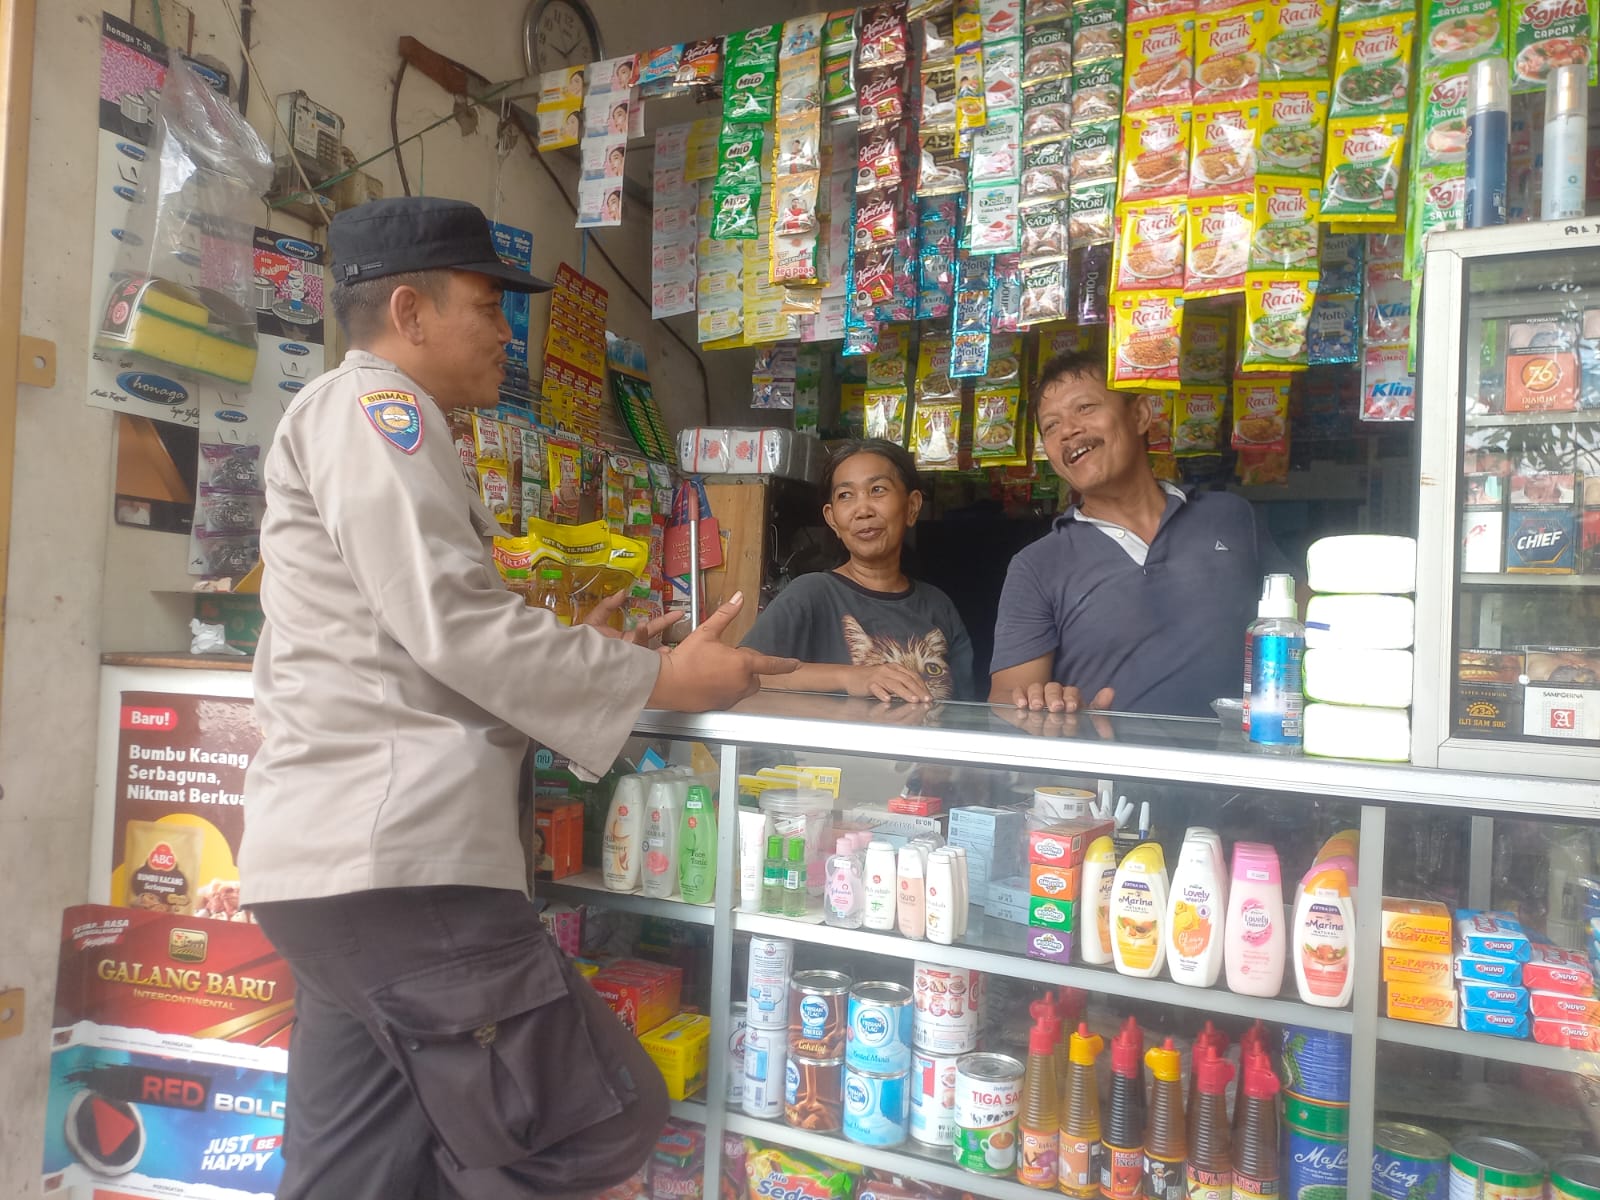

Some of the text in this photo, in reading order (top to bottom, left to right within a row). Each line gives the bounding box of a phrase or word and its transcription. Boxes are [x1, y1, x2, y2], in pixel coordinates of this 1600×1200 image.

[1278, 4, 1322, 24] Racik
[1438, 1, 1492, 16] SAYUR SOP
[1522, 0, 1587, 28] Sajiku
[1209, 24, 1250, 47] Racik
[1534, 24, 1576, 38] CAPCAY
[1032, 34, 1062, 46] SAORI
[1142, 33, 1181, 53] Racik
[1353, 36, 1398, 57] Racik
[738, 75, 763, 88] MILO
[1079, 74, 1110, 87] SAORI
[1031, 94, 1060, 106] SAORI
[1272, 100, 1314, 119] Racik
[1077, 136, 1106, 149] SAORI
[1029, 154, 1059, 167] SAORI
[1073, 200, 1104, 212] SAORI
[1267, 196, 1307, 214] Racik
[1261, 290, 1304, 309] Racik
[1132, 306, 1173, 326] Racik
[1317, 309, 1348, 321] Molto
[132, 377, 186, 400] honaga
[1372, 382, 1412, 397] Klin
[367, 393, 409, 403] BINMAS
[1245, 395, 1279, 408] Racik
[1185, 401, 1217, 413] Racik
[1517, 531, 1562, 550] CHIEF
[131, 711, 170, 726] Baru!
[129, 745, 249, 768] Bumbu Kacang
[128, 765, 221, 785] Serbaguna,
[127, 785, 186, 802] Nikmat
[152, 853, 174, 865] ABC
[1122, 895, 1153, 906] Marina
[1184, 888, 1210, 900] Lovely
[1244, 914, 1269, 925] Lovely
[1309, 919, 1344, 930] Marina
[1484, 965, 1504, 973] NUVO
[98, 959, 276, 1001] GALANG BARU
[1558, 973, 1579, 981] NUVO
[133, 988, 235, 1010] INTERCONTINENTAL
[1565, 1003, 1586, 1011] NUVO
[1568, 1029, 1589, 1037] NUVO
[870, 1055, 890, 1063] Manis
[142, 1076, 205, 1107] RED
[972, 1091, 1002, 1105] TIGA
[204, 1134, 275, 1155] JUST BE
[201, 1153, 274, 1171] HAPPY
